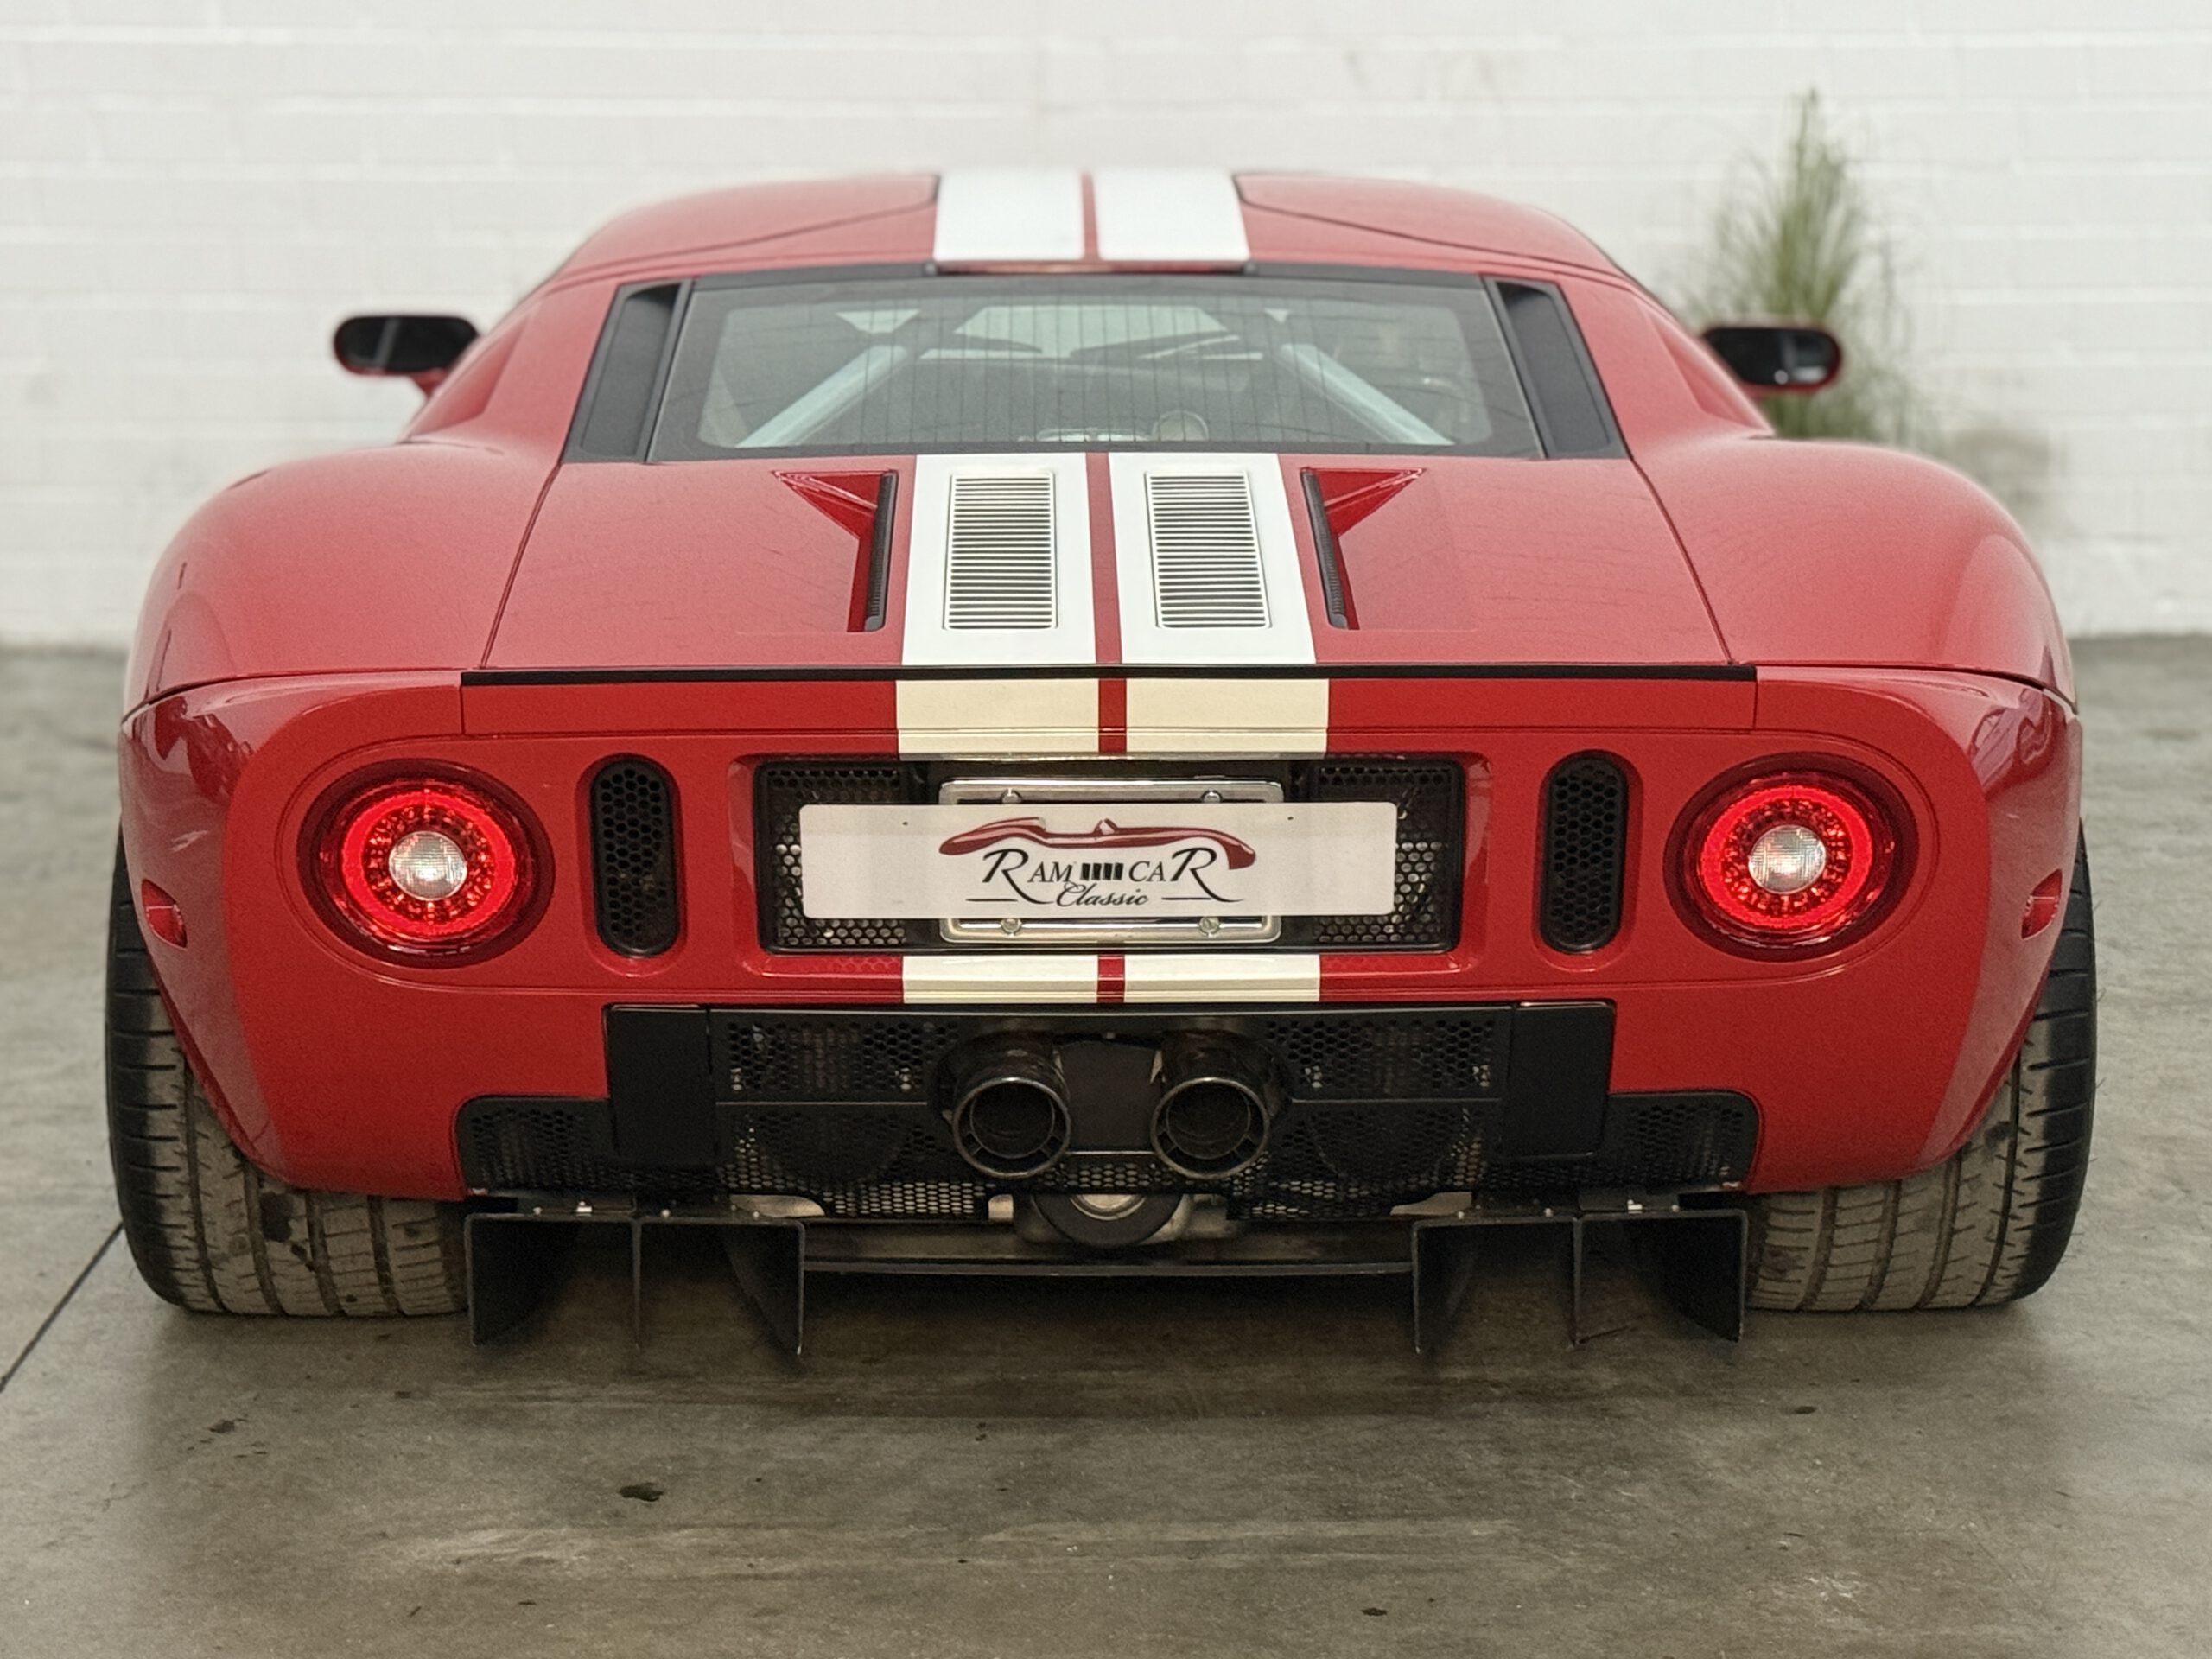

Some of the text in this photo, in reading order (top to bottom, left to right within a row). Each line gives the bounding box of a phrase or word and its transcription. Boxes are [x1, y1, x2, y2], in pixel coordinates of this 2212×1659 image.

[982, 848, 1243, 904] RAM CAR
[1056, 882, 1148, 906] Classic
